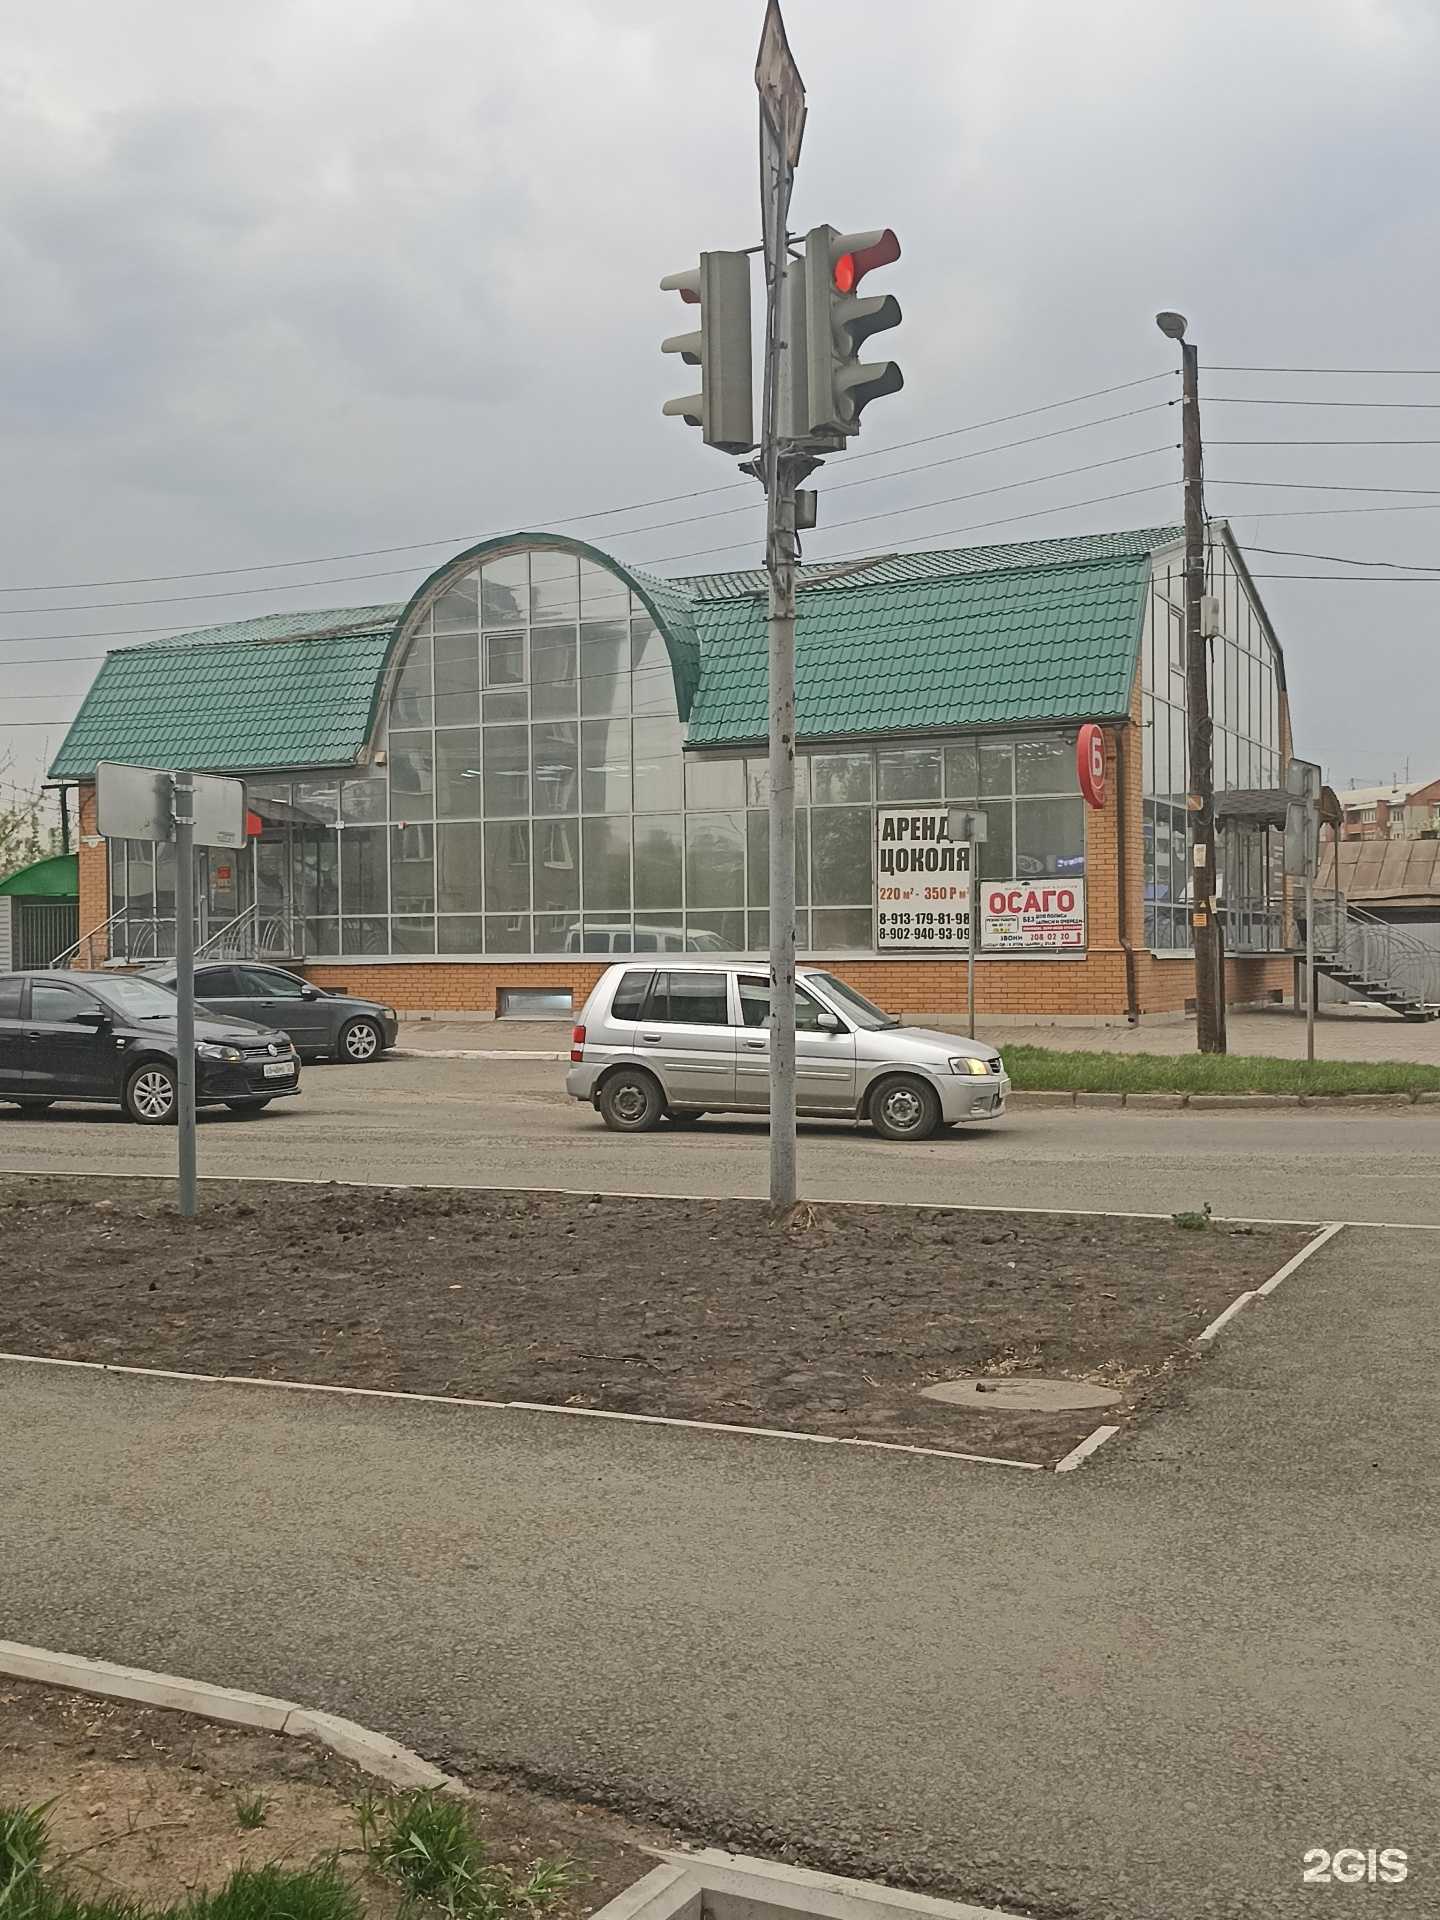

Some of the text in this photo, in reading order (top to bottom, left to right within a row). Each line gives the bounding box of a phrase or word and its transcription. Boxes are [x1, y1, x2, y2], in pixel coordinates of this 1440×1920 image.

[1092, 736, 1102, 776] Б
[882, 816, 953, 844] АРЕНД
[880, 848, 970, 876] ЦОКОЛЯ
[880, 887, 900, 900] 220
[924, 887, 947, 900] 350
[949, 887, 957, 900] Р
[989, 890, 1075, 914] ОСАГО
[879, 912, 970, 925] 8-913-179-81-98
[879, 927, 970, 940] 8-902-940-93-09
